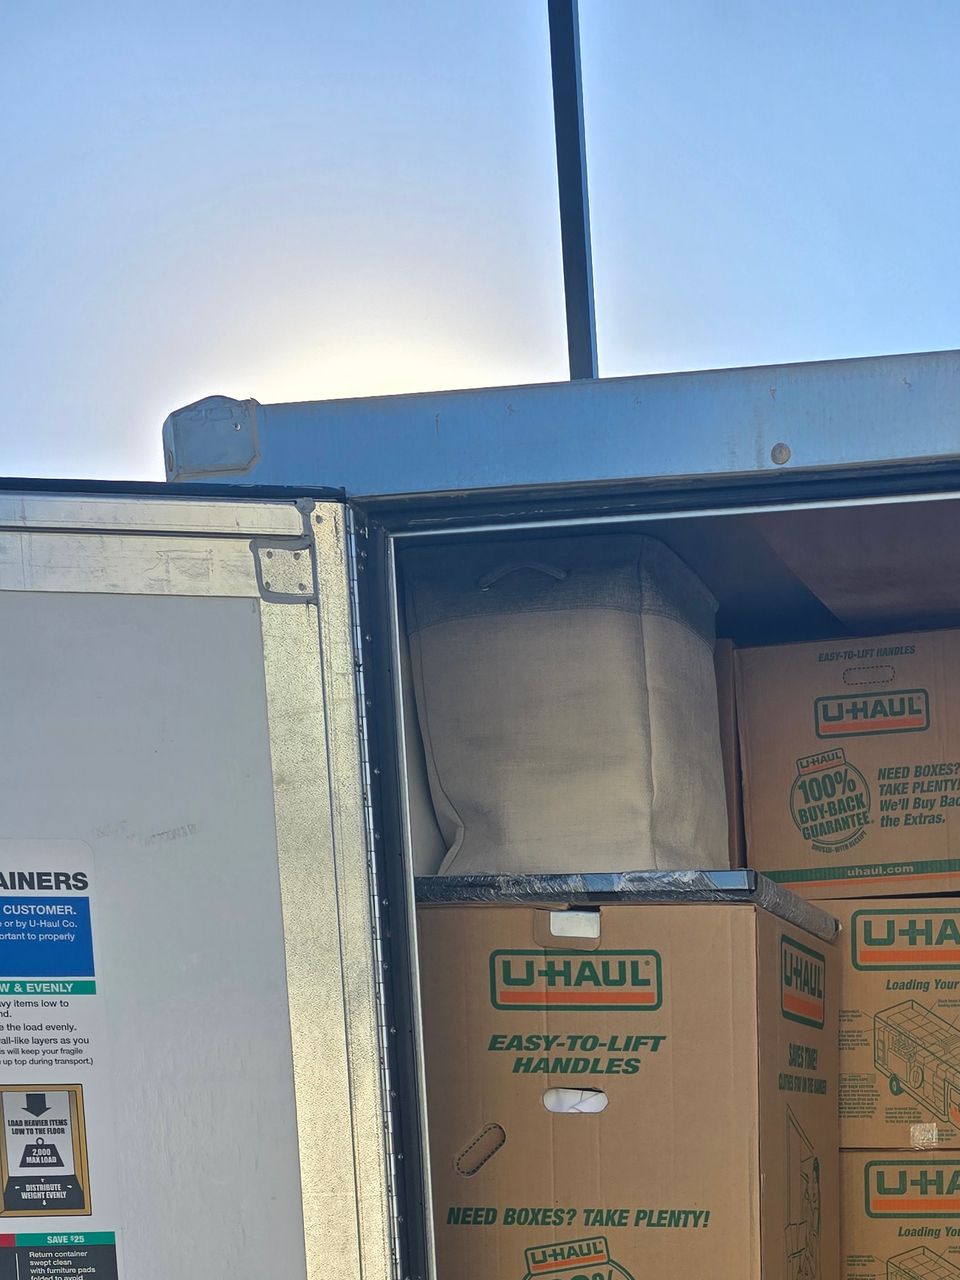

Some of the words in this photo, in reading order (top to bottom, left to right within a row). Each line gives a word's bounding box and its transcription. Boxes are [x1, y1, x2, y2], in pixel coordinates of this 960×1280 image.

[818, 649, 874, 661] EASY-TO-LIFT
[876, 645, 916, 658] HANDLES
[822, 699, 922, 721] U-HAUL
[800, 751, 842, 769] U-HAUL
[878, 767, 911, 780] NEED
[915, 762, 960, 777] BOXES?
[798, 769, 856, 805] 100%
[879, 782, 909, 796] TAKE
[913, 779, 960, 794] PLENTY!
[798, 794, 866, 825] BUY-BACK
[880, 799, 908, 812] We'll
[913, 797, 936, 811] Buy
[802, 812, 870, 841] GUARANTEE
[880, 815, 900, 828] the
[904, 813, 945, 826] Extras.
[847, 864, 914, 876] uhaul.com
[3, 905, 77, 915] CUSTOMER.
[15, 920, 27, 929] by
[29, 920, 60, 928] U-Haul
[62, 920, 78, 928] Co.
[28, 932, 37, 940] to
[38, 932, 75, 942] properly
[502, 956, 651, 988] U-HAUL
[784, 949, 823, 999] U-HAUL
[14, 983, 23, 992] &
[26, 983, 73, 992] EVENLY
[885, 978, 930, 992] Loading
[934, 979, 960, 990] Your
[6, 1023, 21, 1031] the
[23, 1023, 43, 1031] load
[45, 1023, 77, 1033] evenly.
[32, 1037, 58, 1046] layers
[73, 1038, 90, 1046] you
[488, 1034, 666, 1053] EASY-TO-LIFT
[21, 1048, 40, 1056] keep
[60, 1048, 83, 1056] fragile
[29, 1058, 53, 1066] during
[513, 1055, 640, 1075] HANDLES
[446, 1207, 498, 1227] NEED
[502, 1207, 577, 1227] BOXES?
[583, 1208, 631, 1228] TAKE
[635, 1210, 710, 1229] PLENTY!
[47, 1236, 68, 1244] SAVE
[70, 1235, 85, 1243] $25
[898, 1226, 941, 1239] Loading
[530, 1242, 604, 1264] U-HAUL
